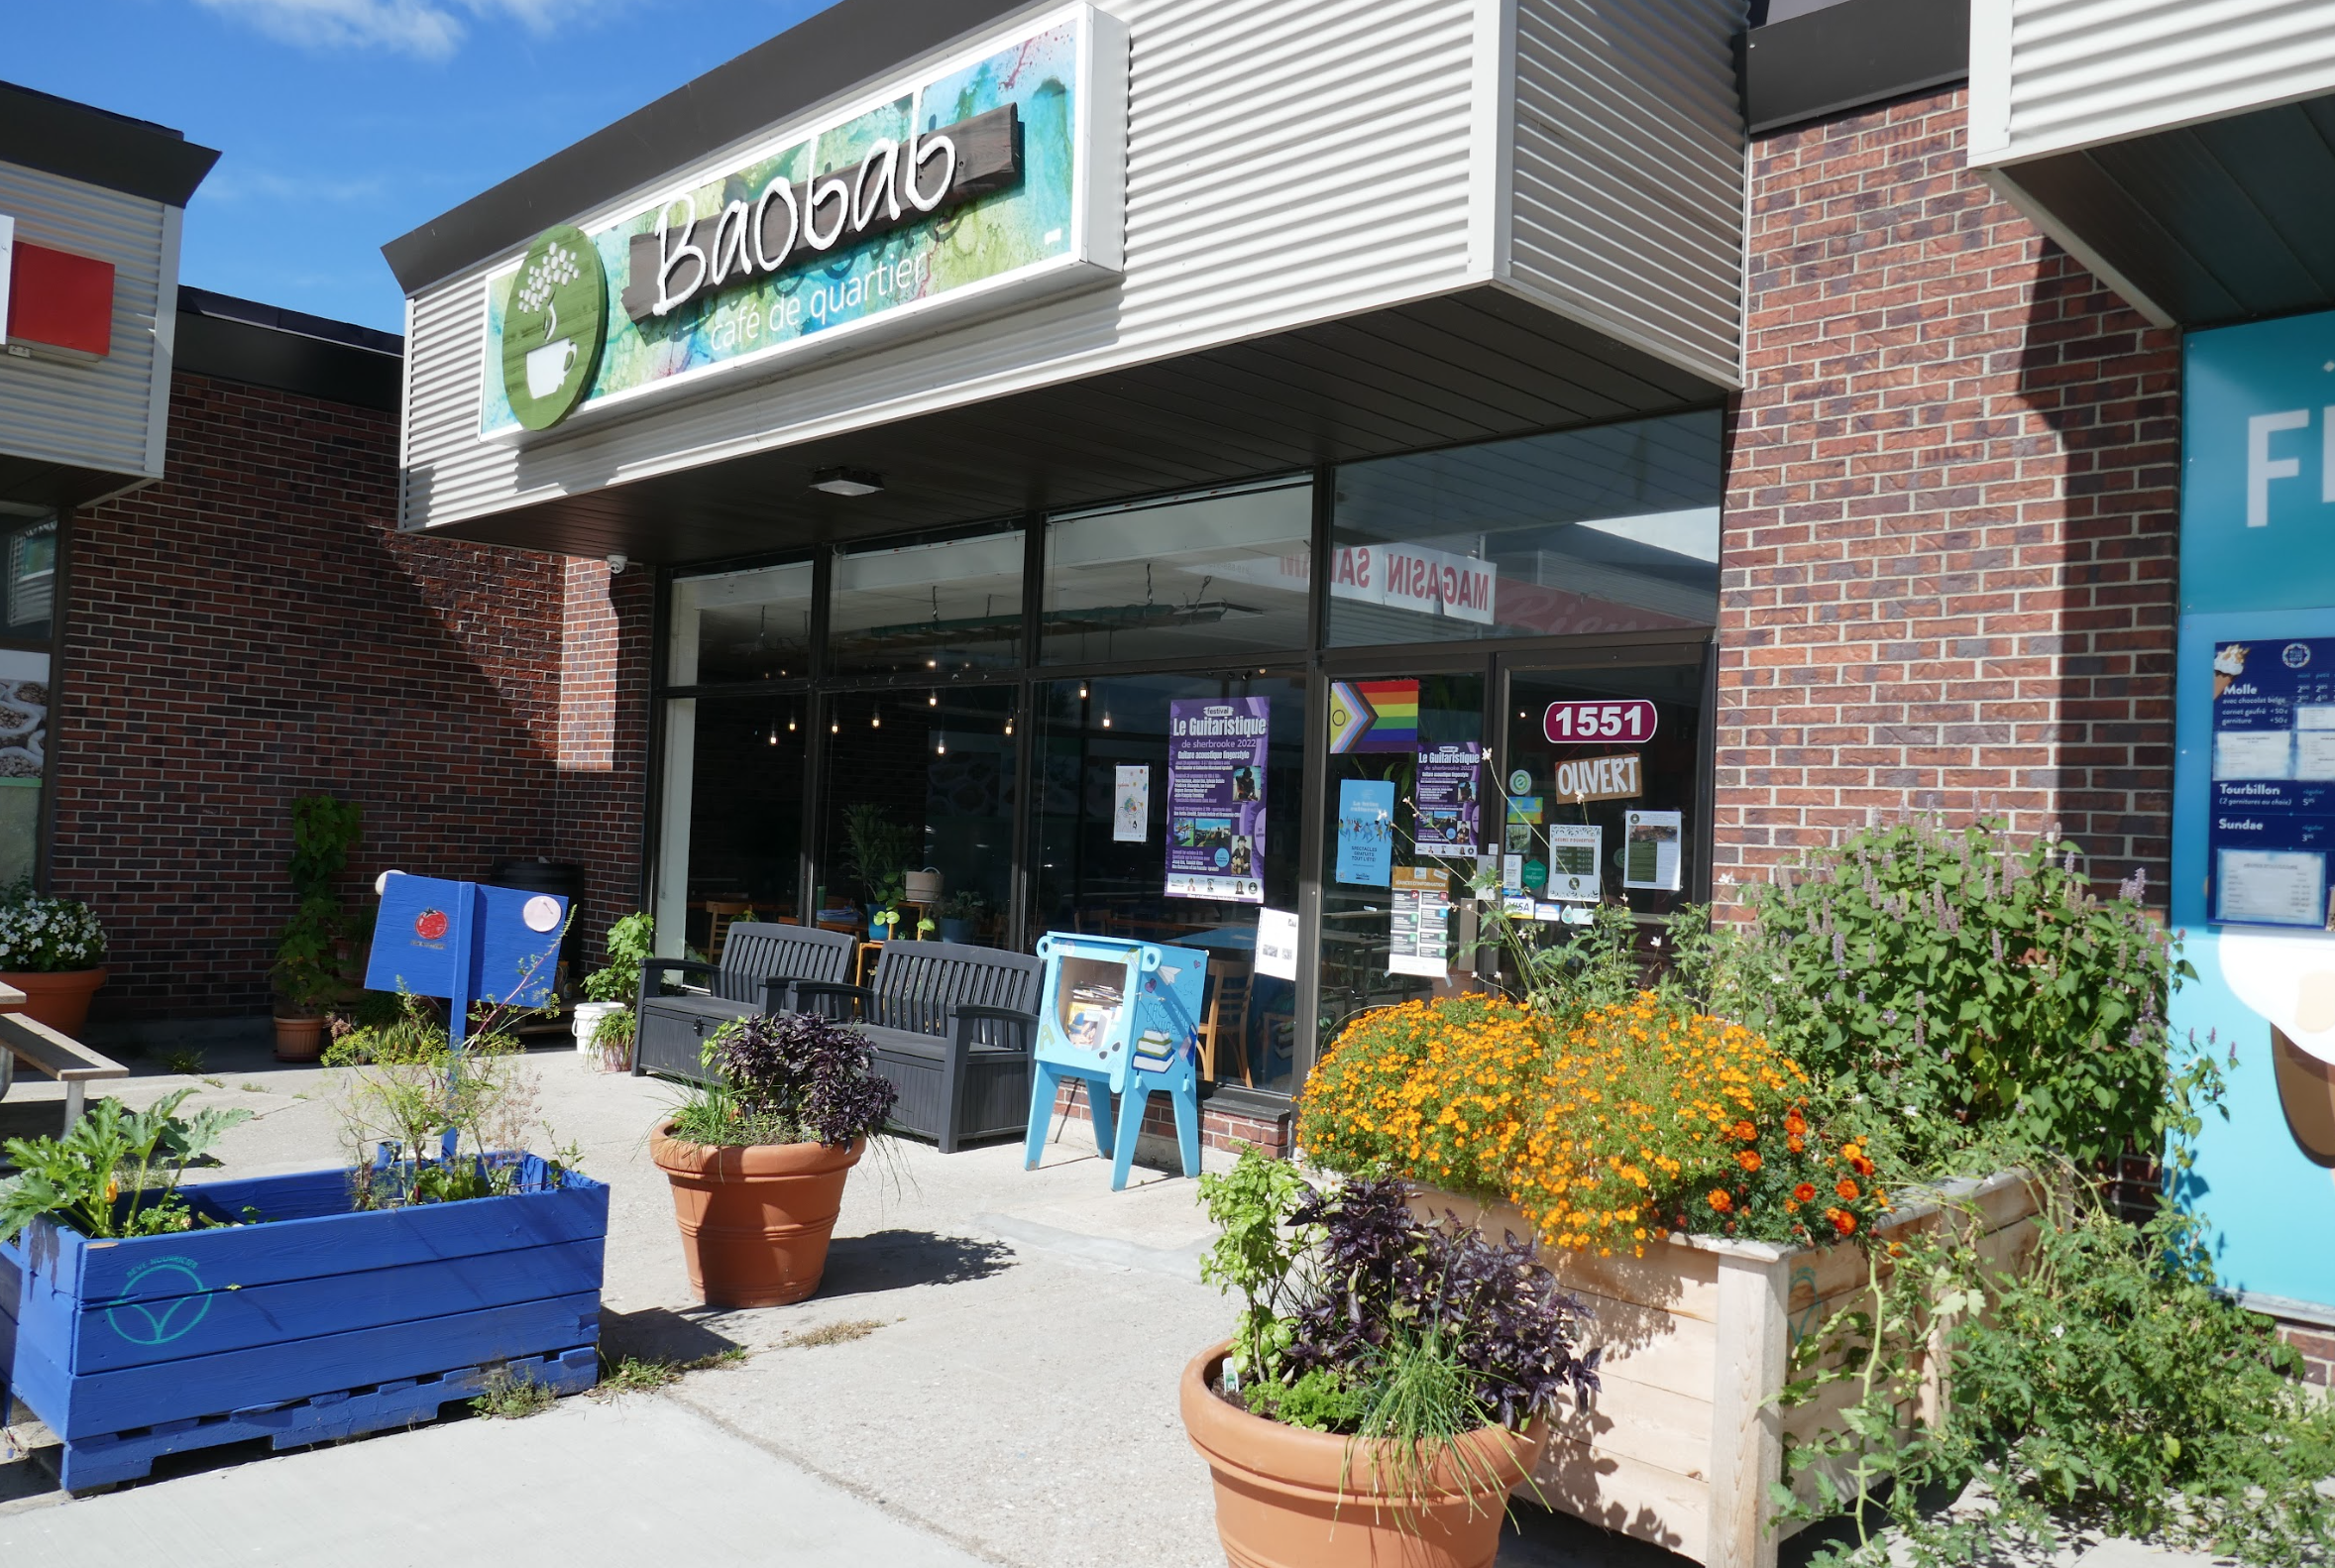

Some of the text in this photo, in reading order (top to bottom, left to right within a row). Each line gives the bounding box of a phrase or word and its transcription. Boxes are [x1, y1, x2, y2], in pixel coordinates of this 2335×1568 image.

[652, 85, 957, 317] Baobab
[710, 250, 929, 353] café de quartier
[2223, 683, 2258, 696] Molle
[2245, 707, 2267, 717] gaufré
[1173, 716, 1267, 737] Le Guitaristique
[1556, 706, 1642, 736] 1551
[2222, 717, 2253, 727] garniture
[1181, 739, 1191, 748] de
[1193, 739, 1236, 748] sherbrooke
[1419, 751, 1480, 765] Le Guitaristique
[1558, 756, 1638, 796] OUVERT
[2219, 783, 2280, 795] Tourbillon
[2228, 798, 2261, 807] garnitures
[2218, 818, 2264, 831] Sundae
